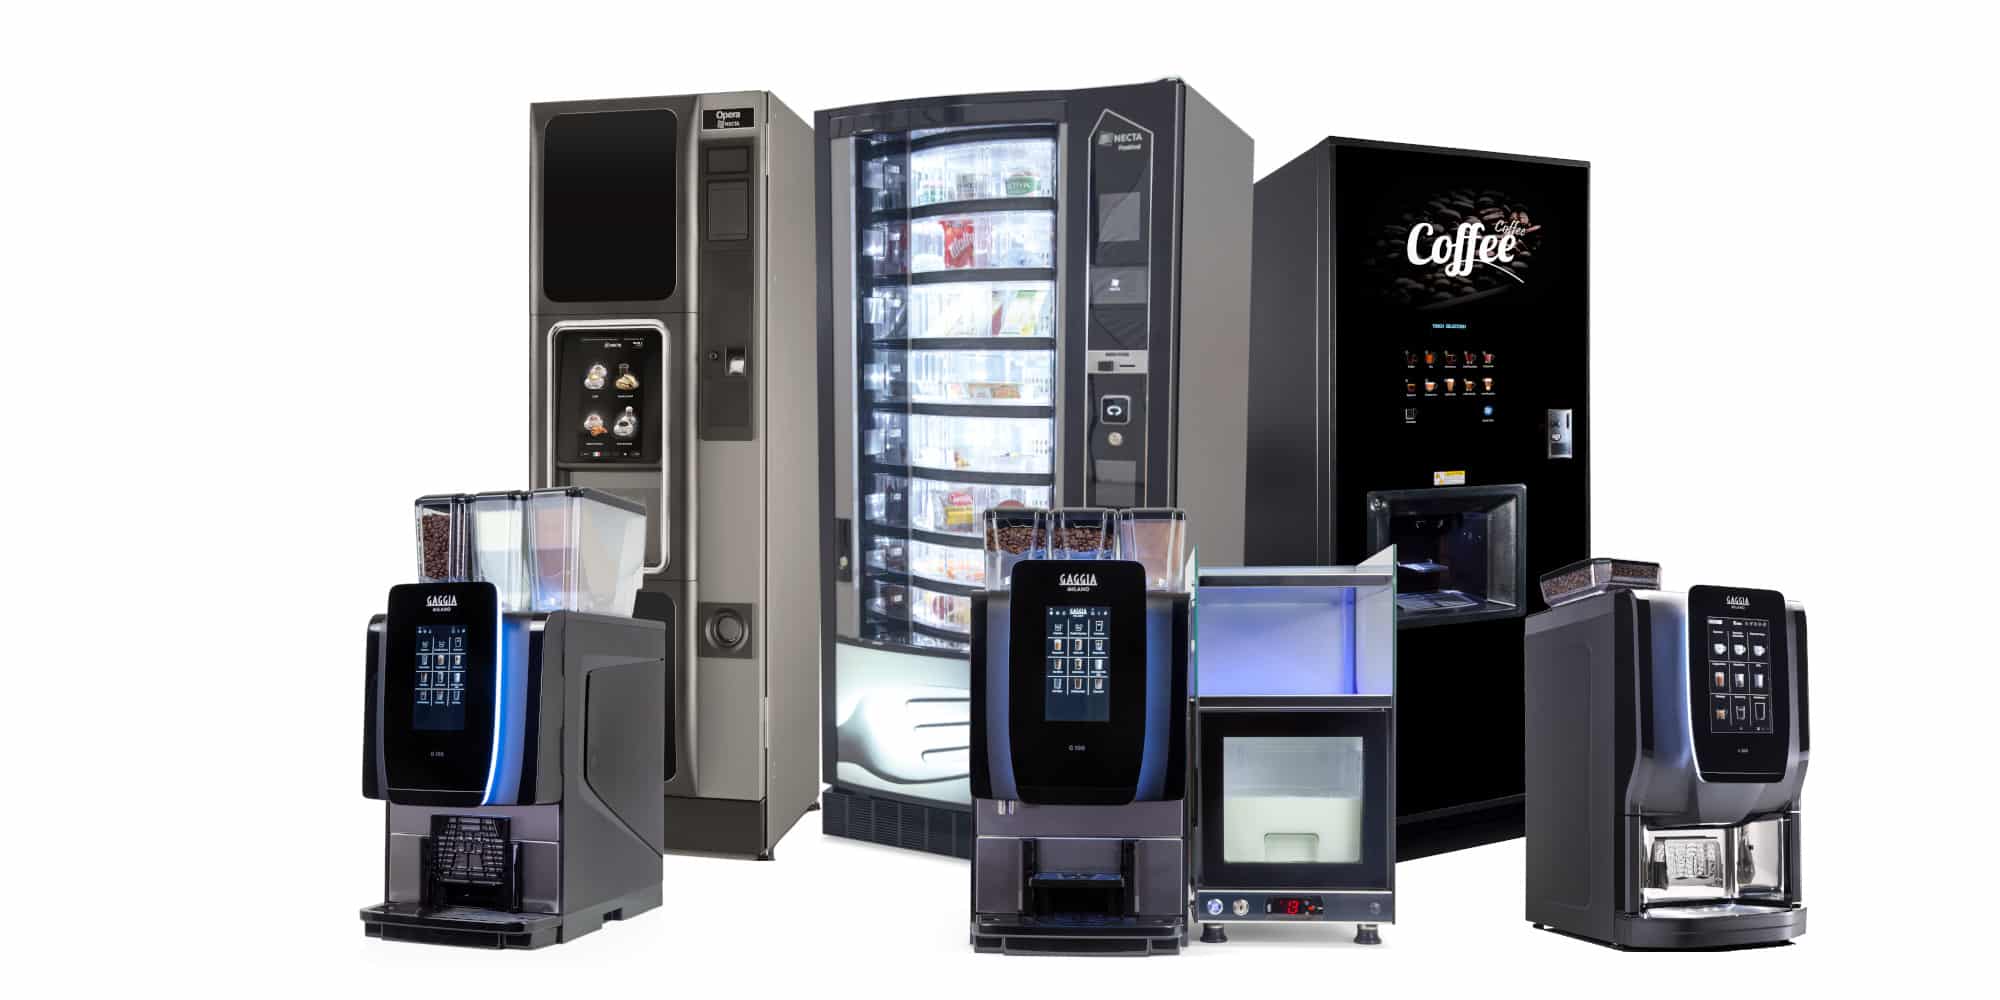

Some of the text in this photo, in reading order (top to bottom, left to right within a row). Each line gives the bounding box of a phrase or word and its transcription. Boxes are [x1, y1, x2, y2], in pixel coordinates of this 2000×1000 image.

[716, 110, 741, 121] Opera
[1113, 132, 1143, 143] NECTA
[1494, 219, 1526, 237] Coffee
[1406, 222, 1516, 277] Coffee
[1058, 573, 1098, 586] GAGGIA
[425, 594, 458, 607] GAGGIA
[1726, 595, 1751, 606] GAGGIA
